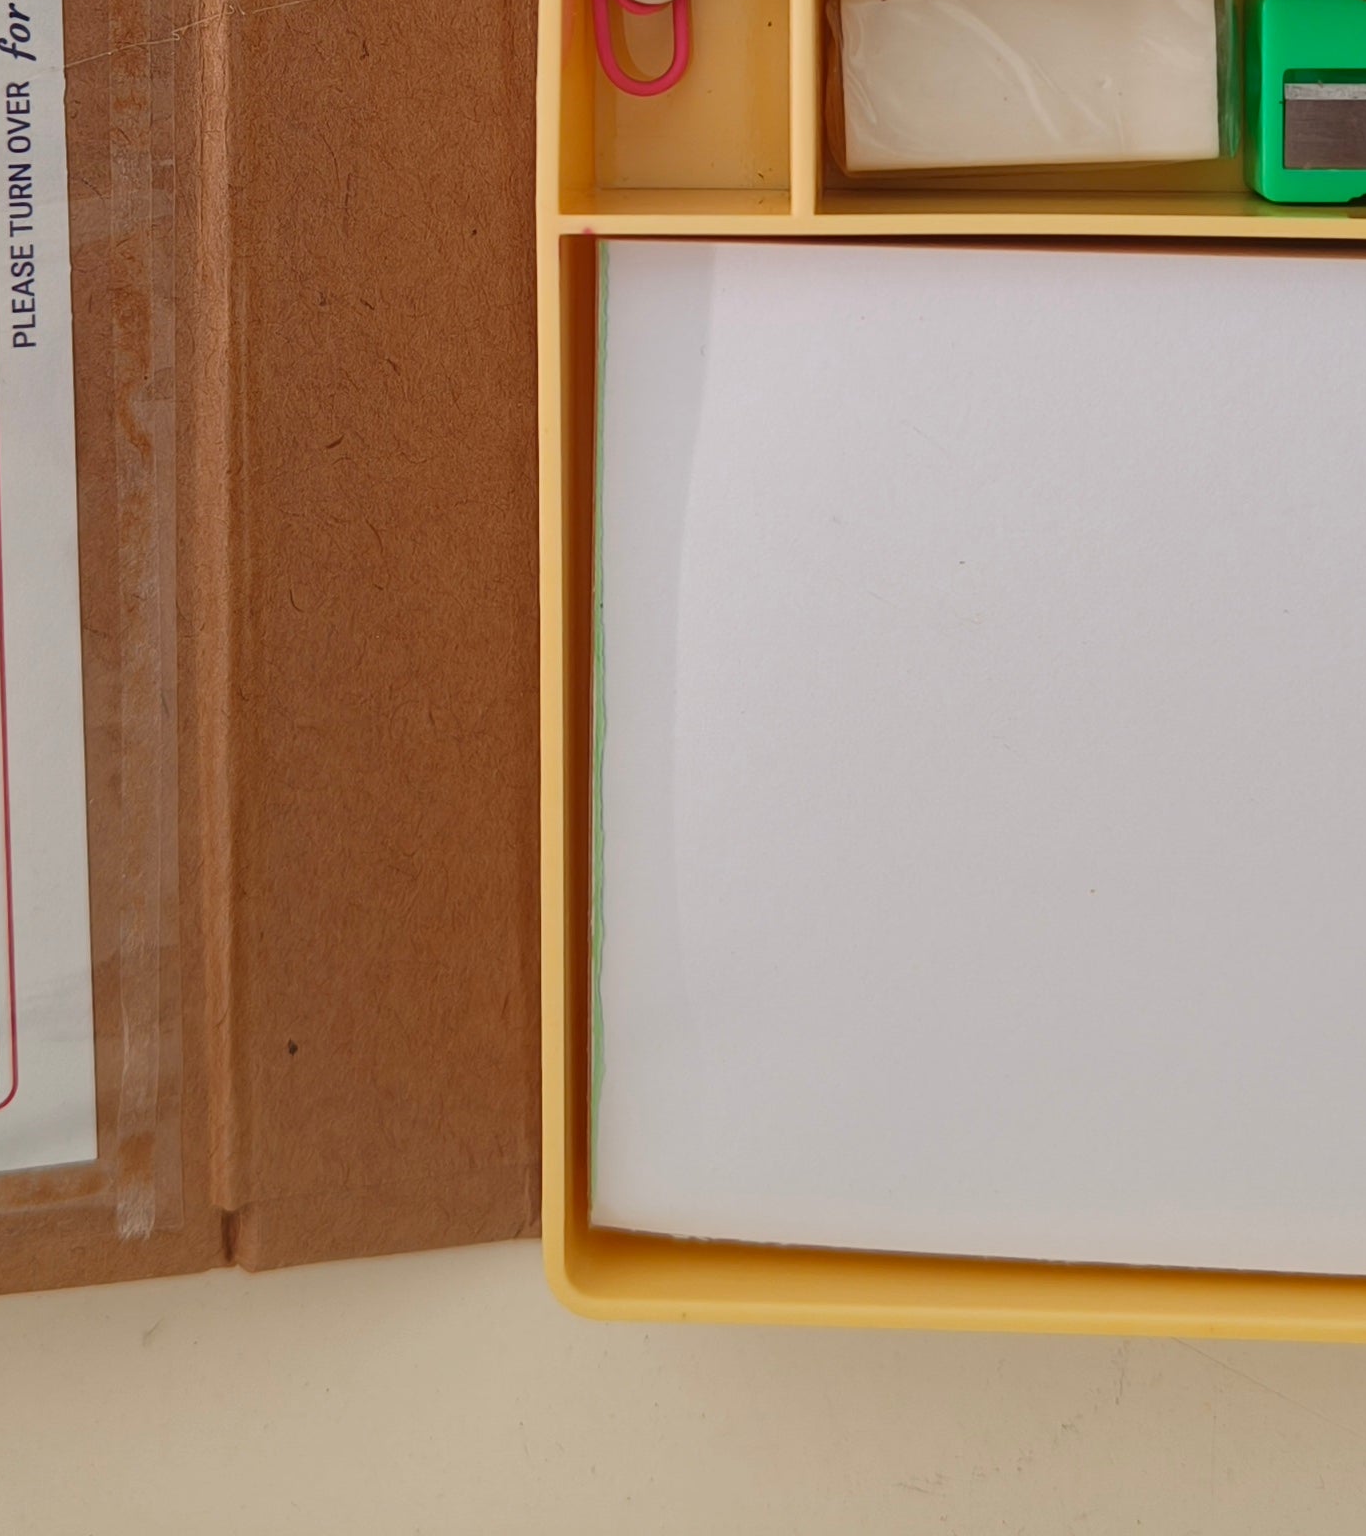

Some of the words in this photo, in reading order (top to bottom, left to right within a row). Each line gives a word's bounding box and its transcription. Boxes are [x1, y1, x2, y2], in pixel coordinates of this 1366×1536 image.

[5, 81, 31, 154] OVER
[7, 163, 33, 238] TURN
[10, 244, 37, 348] PLEASE
